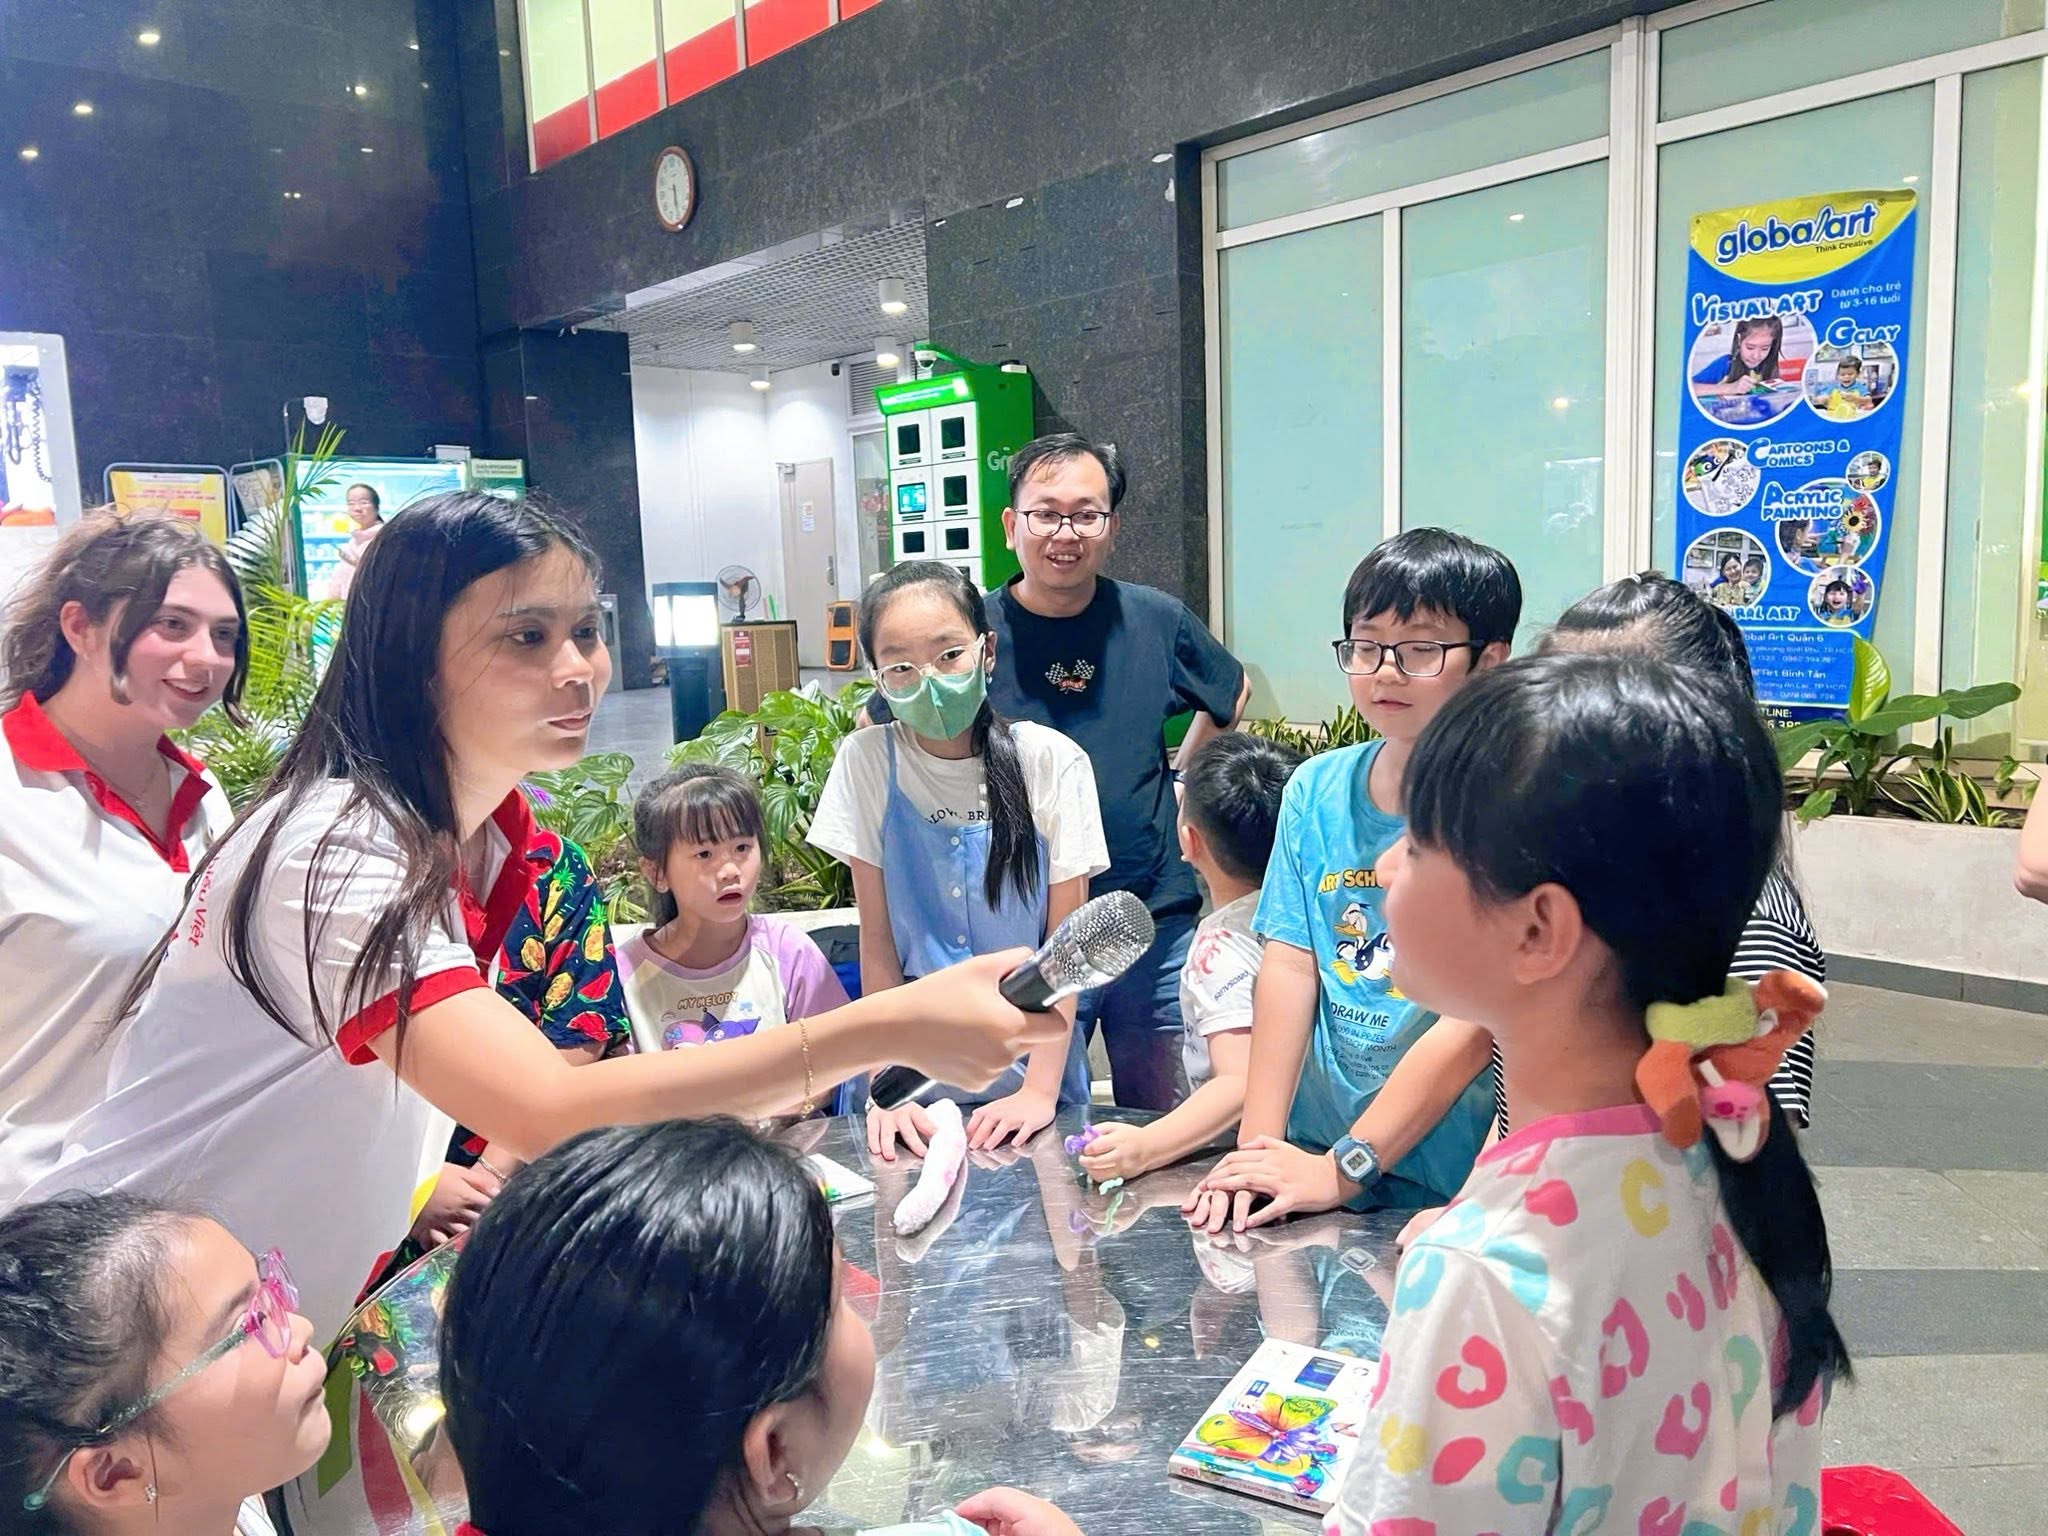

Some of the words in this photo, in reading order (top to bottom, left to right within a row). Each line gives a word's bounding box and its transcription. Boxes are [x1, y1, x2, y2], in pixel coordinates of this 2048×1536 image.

[1815, 245, 1837, 254] Think
[1838, 239, 1874, 251] Creative
[1831, 288, 1860, 299] Dành
[1862, 284, 1883, 295] cho
[1692, 293, 1772, 327] VISUAL
[1775, 290, 1823, 315] ART
[1852, 296, 1877, 308] 3-16
[987, 450, 1008, 471] Gr
[1746, 437, 1835, 468] CARTOONS
[1837, 439, 1850, 452] &
[1762, 481, 1843, 506] ACRYLIC
[1762, 504, 1843, 521] PAINTING
[1733, 606, 1763, 620] RAL
[1767, 606, 1800, 621] ART
[1744, 632, 1766, 641] obal
[1768, 633, 1784, 641] Art
[1817, 633, 1825, 643] 6
[1761, 707, 1792, 718] TLINE:
[1318, 872, 1340, 894] ART
[1343, 868, 1384, 889] SCH
[188, 908, 207, 947] Việt
[677, 998, 697, 1010] MY
[697, 991, 738, 1009] MELODY
[1330, 1002, 1369, 1024] DRAW
[1370, 1013, 1390, 1028] ME
[1367, 1043, 1397, 1053] MONTH
